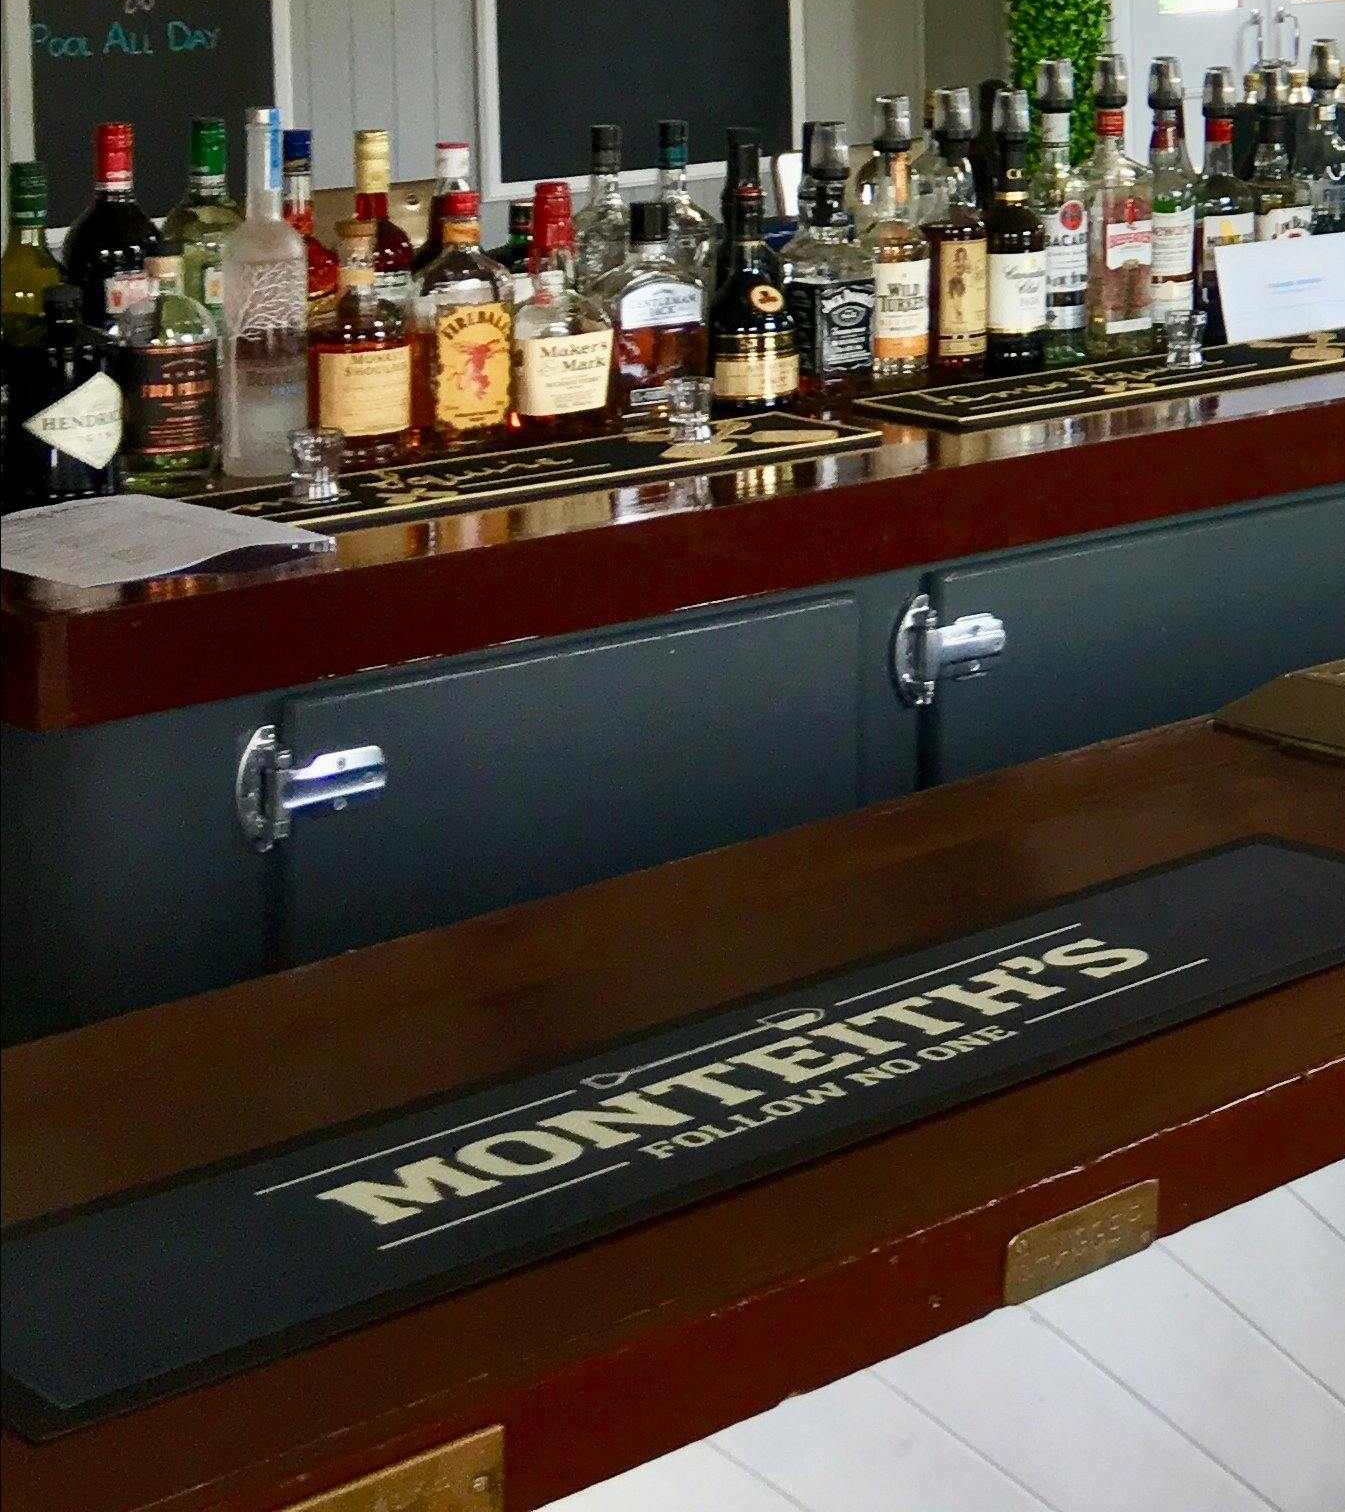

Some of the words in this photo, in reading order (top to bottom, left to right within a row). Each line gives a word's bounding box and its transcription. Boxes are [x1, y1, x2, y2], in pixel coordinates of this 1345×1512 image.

[316, 938, 1149, 1225] MONTEITH'S
[639, 1081, 848, 1160] FOLLOW
[855, 1056, 925, 1087] NO
[916, 1024, 1020, 1064] ONE
